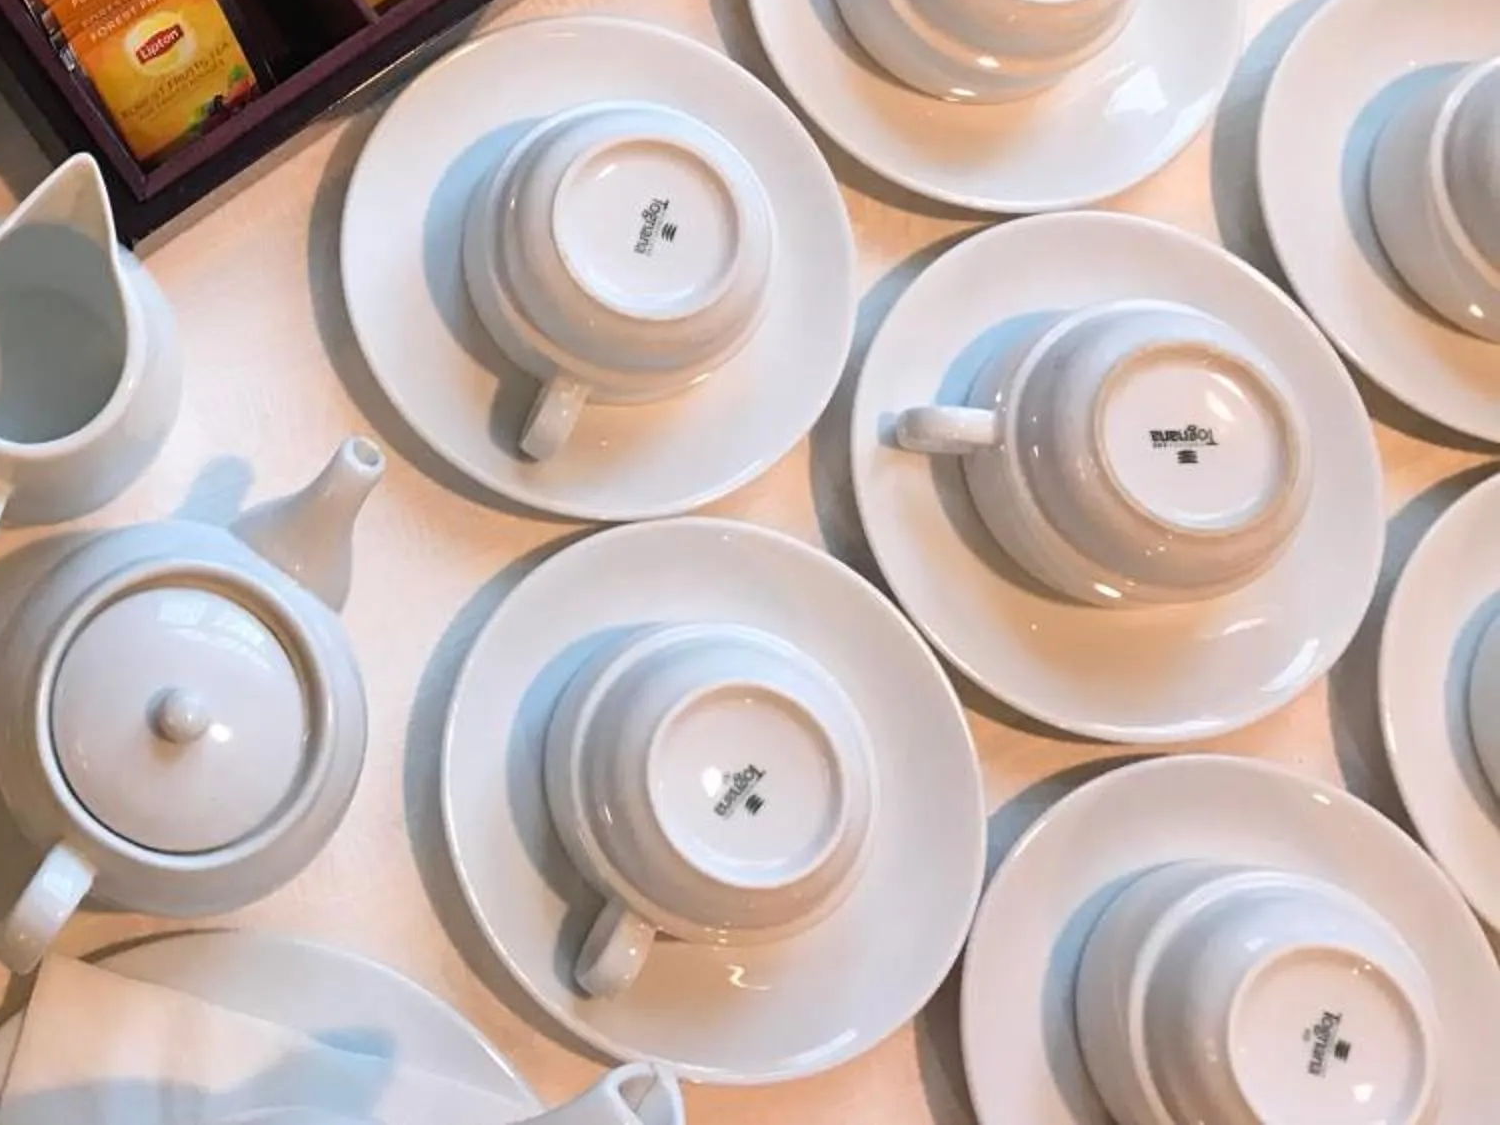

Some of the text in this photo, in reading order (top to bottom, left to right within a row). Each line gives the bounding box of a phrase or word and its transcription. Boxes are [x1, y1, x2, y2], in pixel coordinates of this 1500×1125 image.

[90, 6, 137, 42] FOREST
[140, 29, 180, 60] Lipton
[1149, 425, 1219, 446] Tognana
